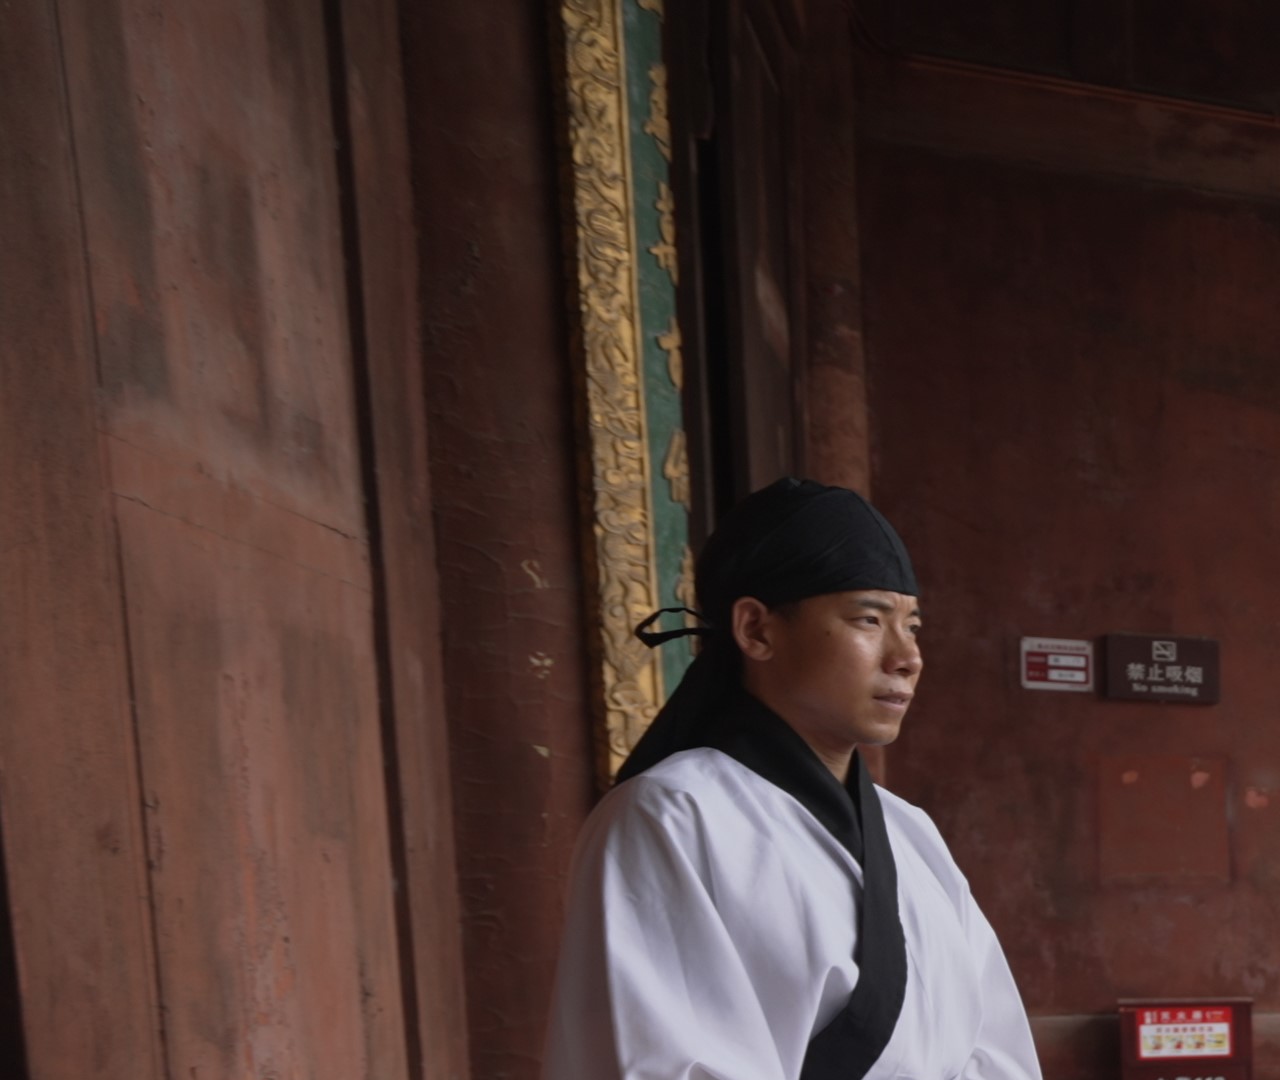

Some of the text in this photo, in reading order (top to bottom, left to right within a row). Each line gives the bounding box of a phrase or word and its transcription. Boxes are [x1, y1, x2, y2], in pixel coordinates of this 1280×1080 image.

[1127, 663, 1203, 683] 禁止吸烟
[1132, 683, 1199, 697] No smoking
